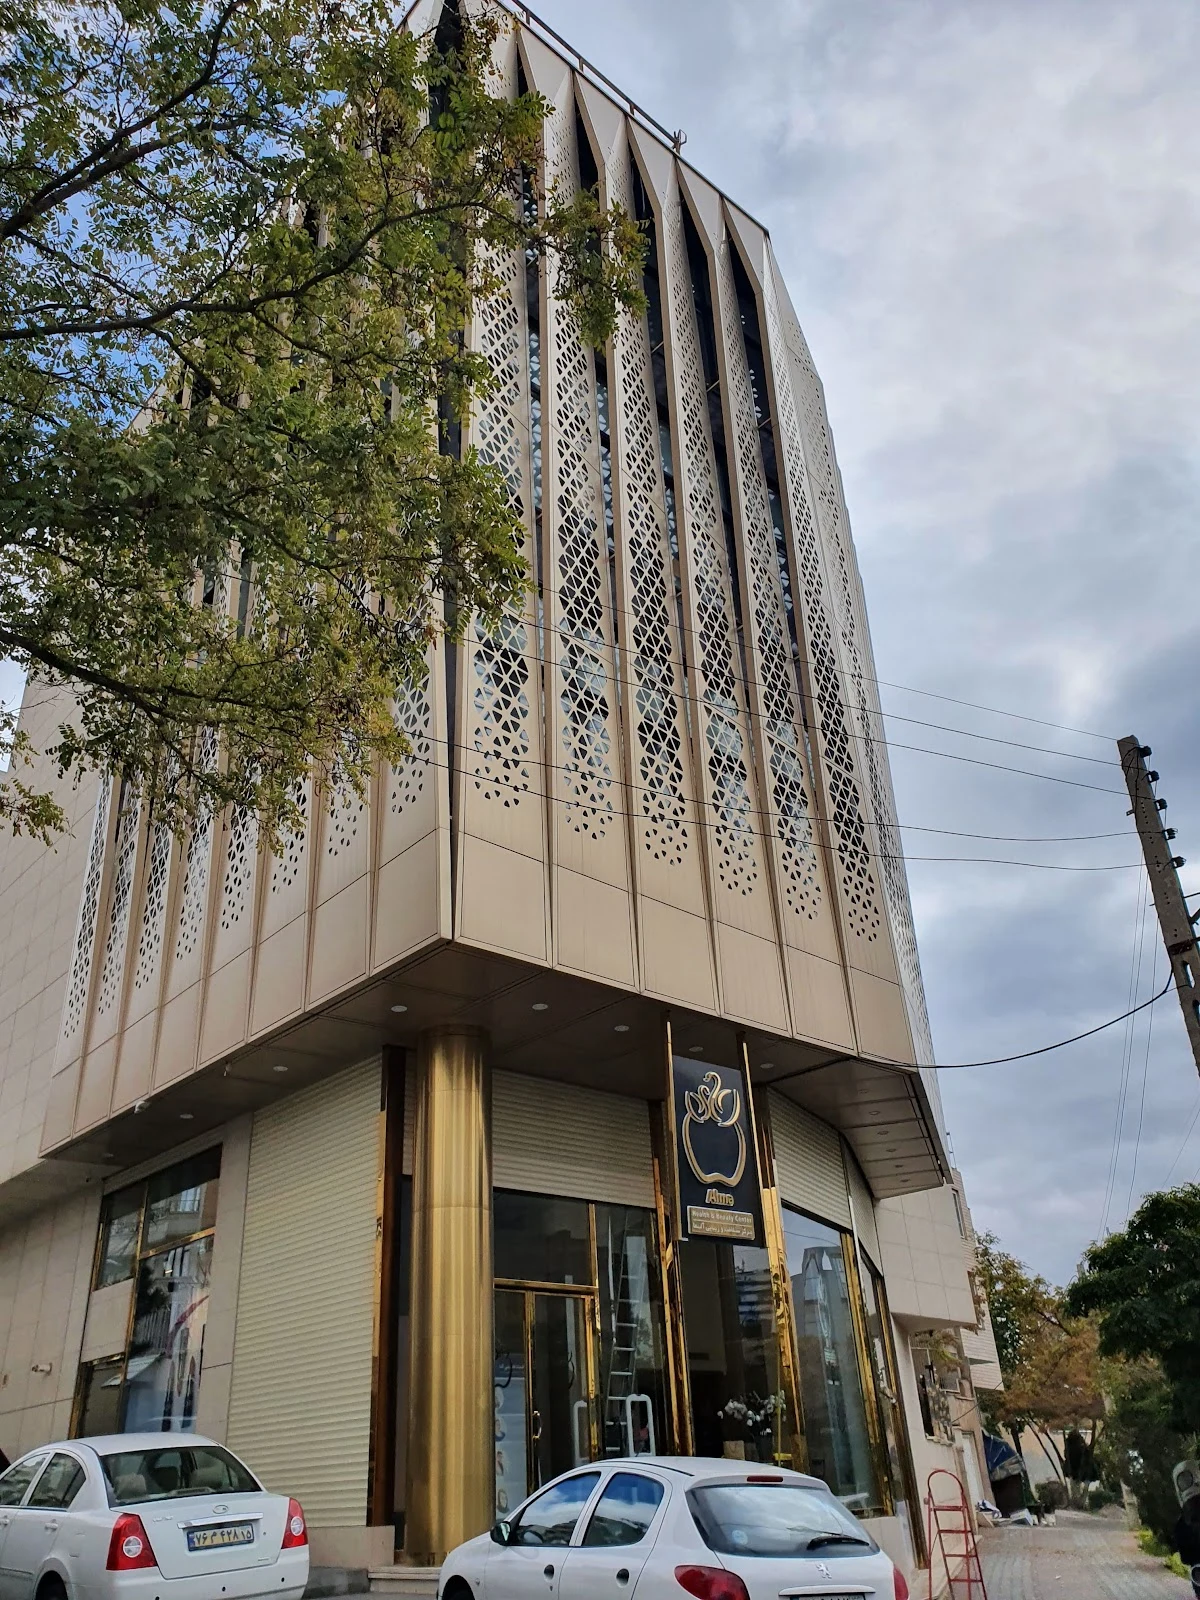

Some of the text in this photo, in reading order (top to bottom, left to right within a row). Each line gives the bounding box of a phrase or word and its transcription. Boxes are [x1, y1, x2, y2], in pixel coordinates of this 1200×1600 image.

[705, 1188, 734, 1206] Alma
[692, 1210, 710, 1219] Health
[715, 1213, 734, 1222] Beauty
[735, 1215, 752, 1223] Center
